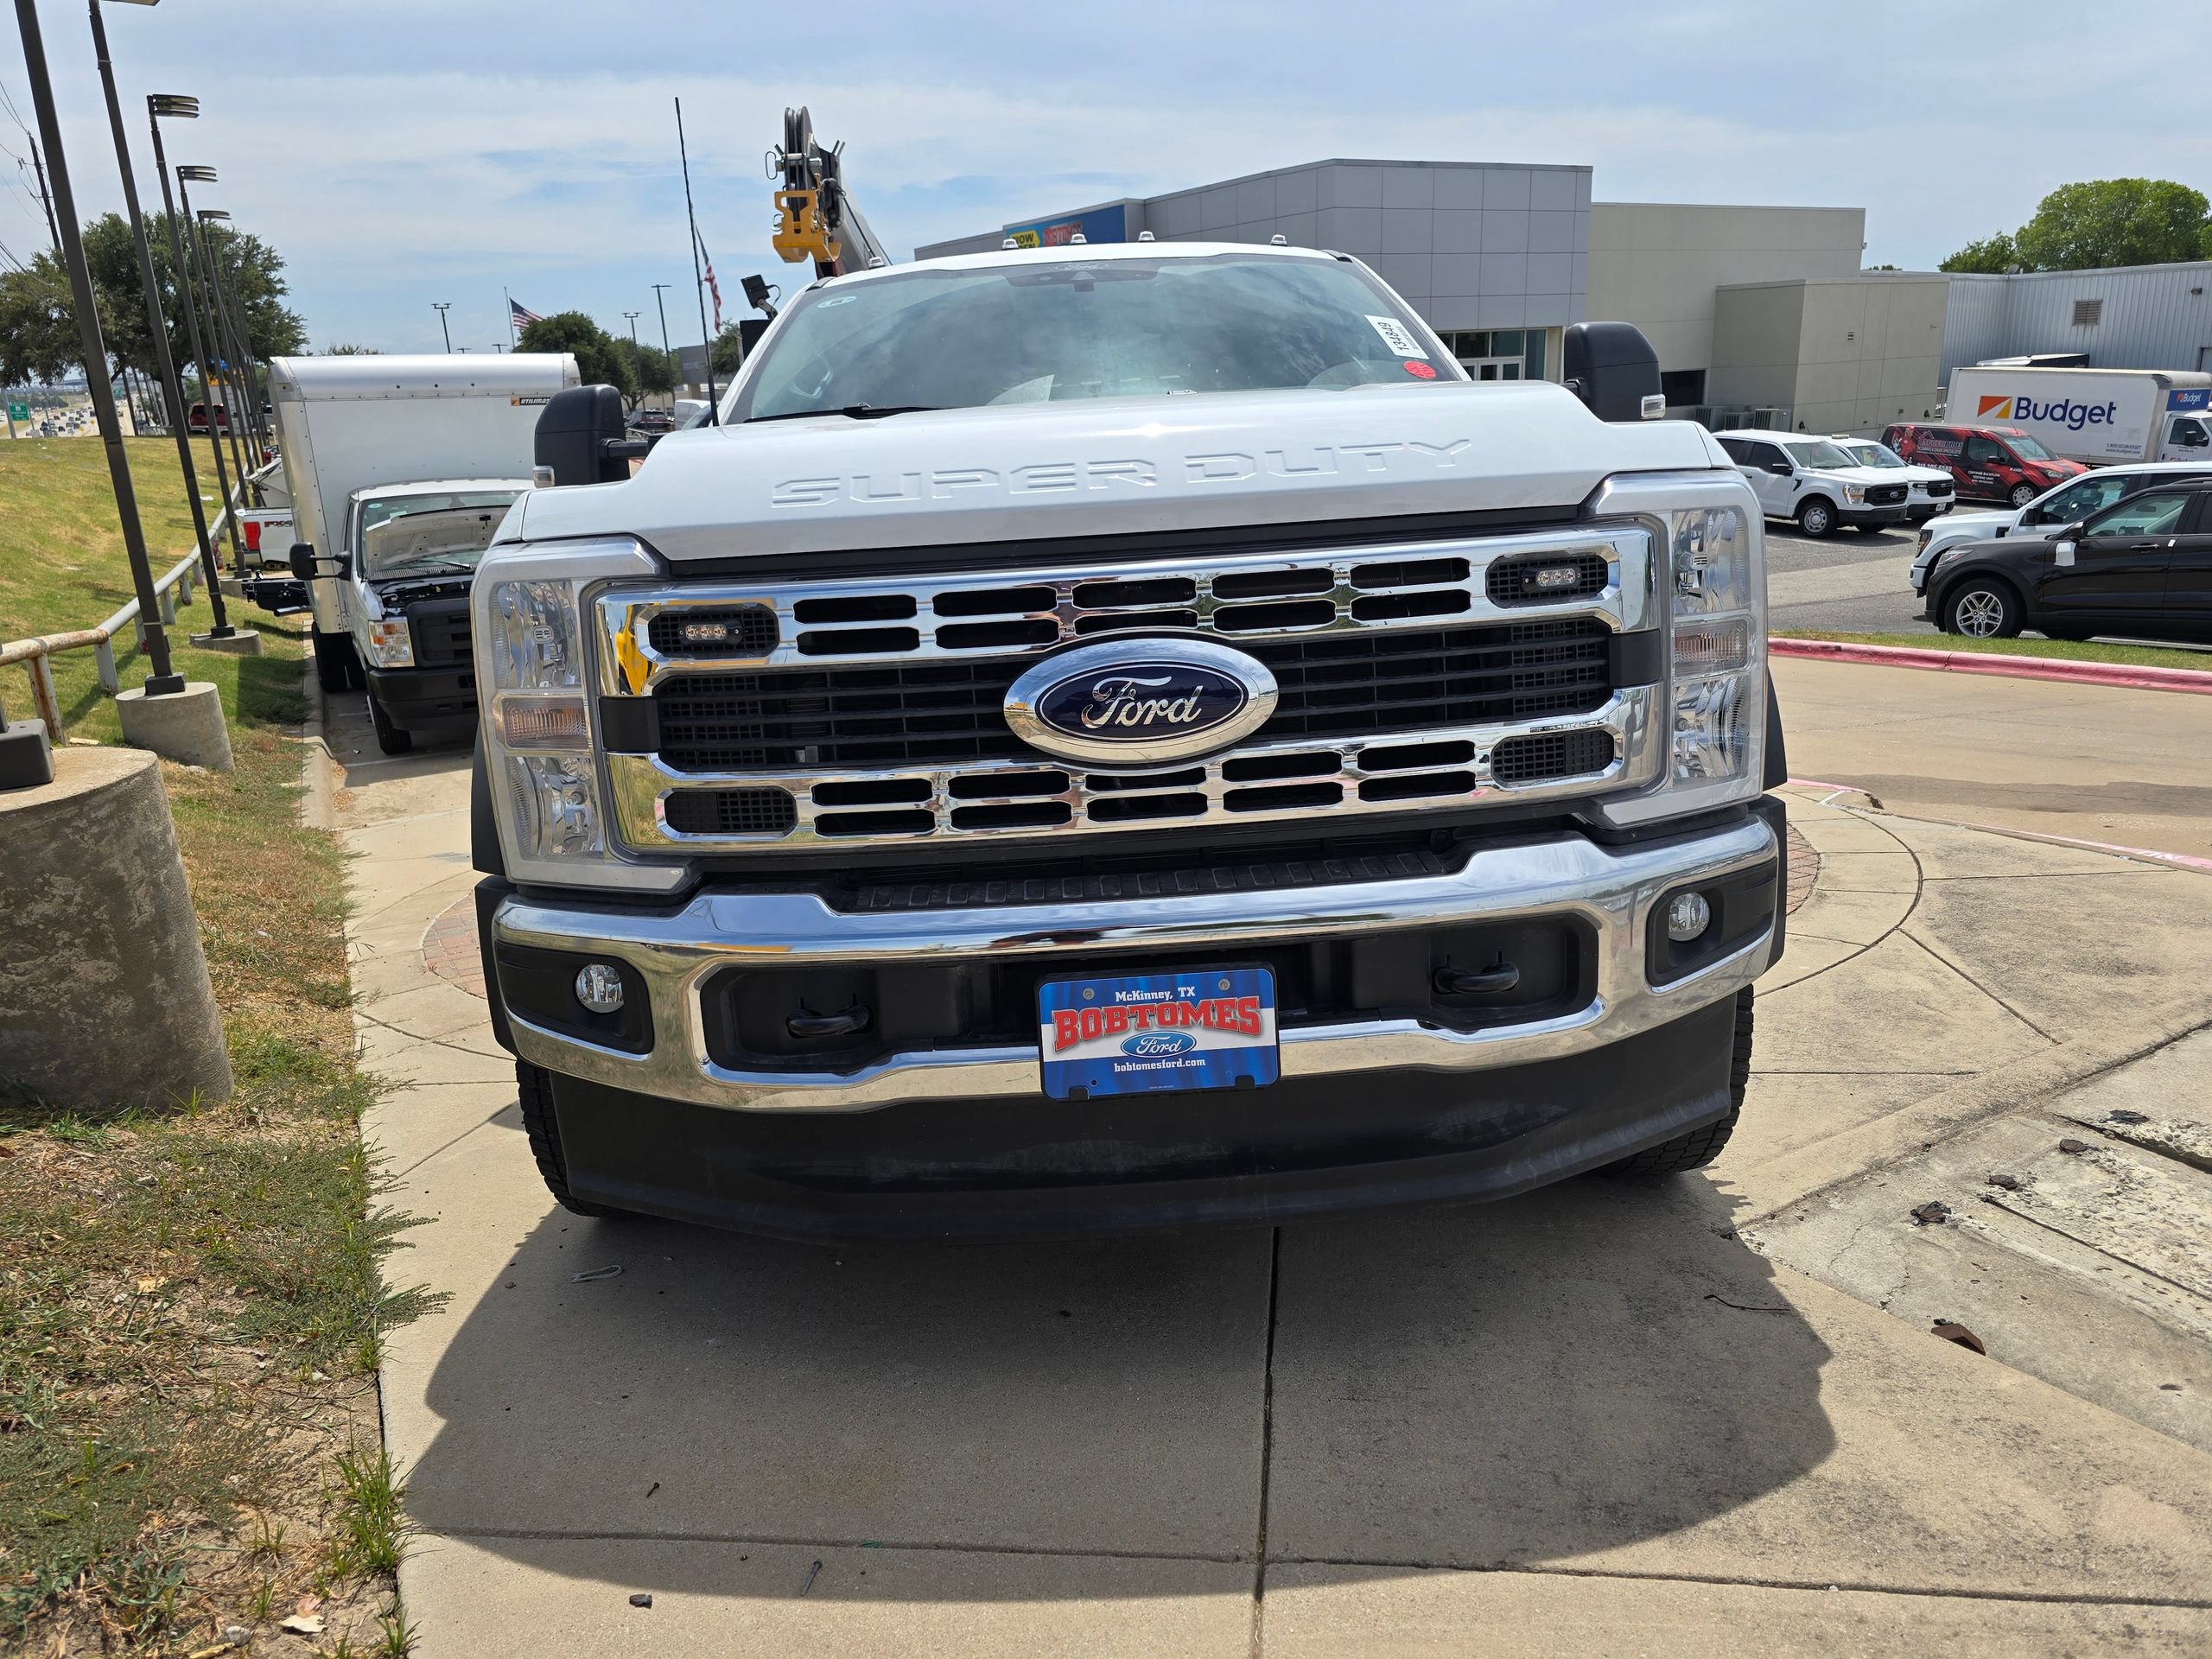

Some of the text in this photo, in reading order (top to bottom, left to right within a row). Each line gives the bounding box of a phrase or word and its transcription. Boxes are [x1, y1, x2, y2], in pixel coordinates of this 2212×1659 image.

[1376, 321, 1410, 351] 134849
[2183, 393, 2202, 405] Budget
[2014, 397, 2117, 431] Budget
[771, 438, 1472, 509] SUPER DUTY
[1081, 676, 1204, 729] Ford
[1115, 986, 1196, 1002] McKinney, TX
[1135, 1035, 1182, 1055] Ford
[1114, 1058, 1206, 1072] bobtomesford.com
